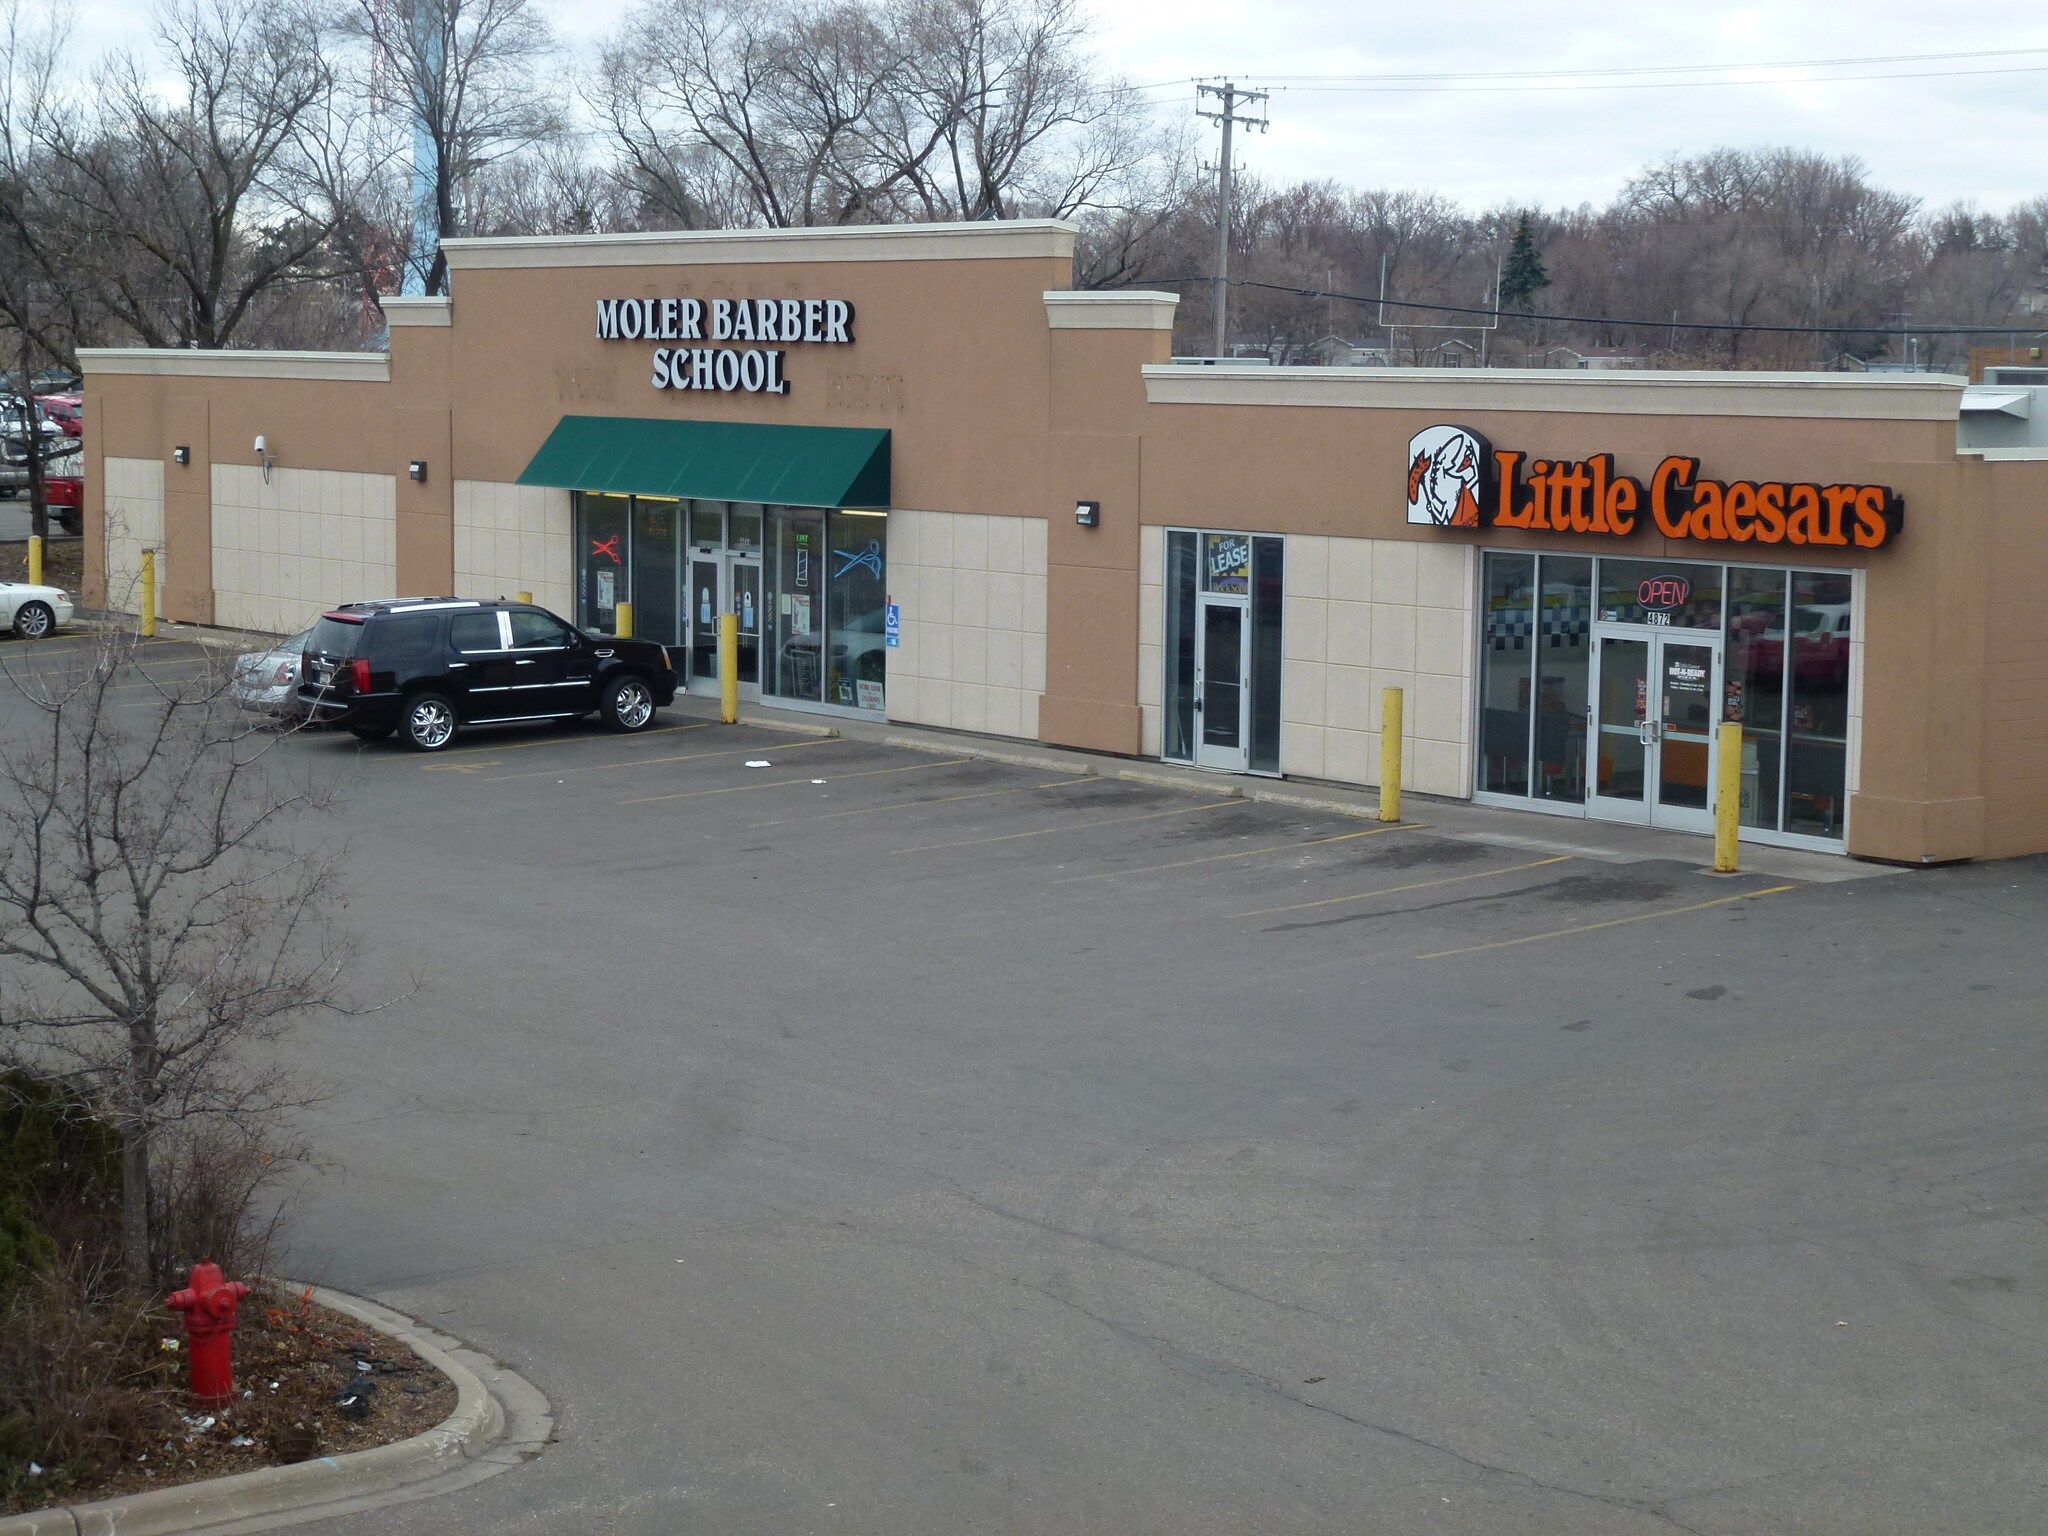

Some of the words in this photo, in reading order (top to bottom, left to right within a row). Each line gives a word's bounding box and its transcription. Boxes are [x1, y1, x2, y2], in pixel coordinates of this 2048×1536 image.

[596, 298, 706, 341] MOLER
[712, 299, 855, 343] BARBER
[651, 347, 790, 394] SCHOOL
[1493, 450, 1639, 536] Little
[1651, 455, 1893, 549] Caesars
[1210, 544, 1248, 574] LEASE
[1219, 538, 1235, 552] FOR
[1638, 580, 1686, 605] OPEN
[1647, 612, 1670, 626] 4872
